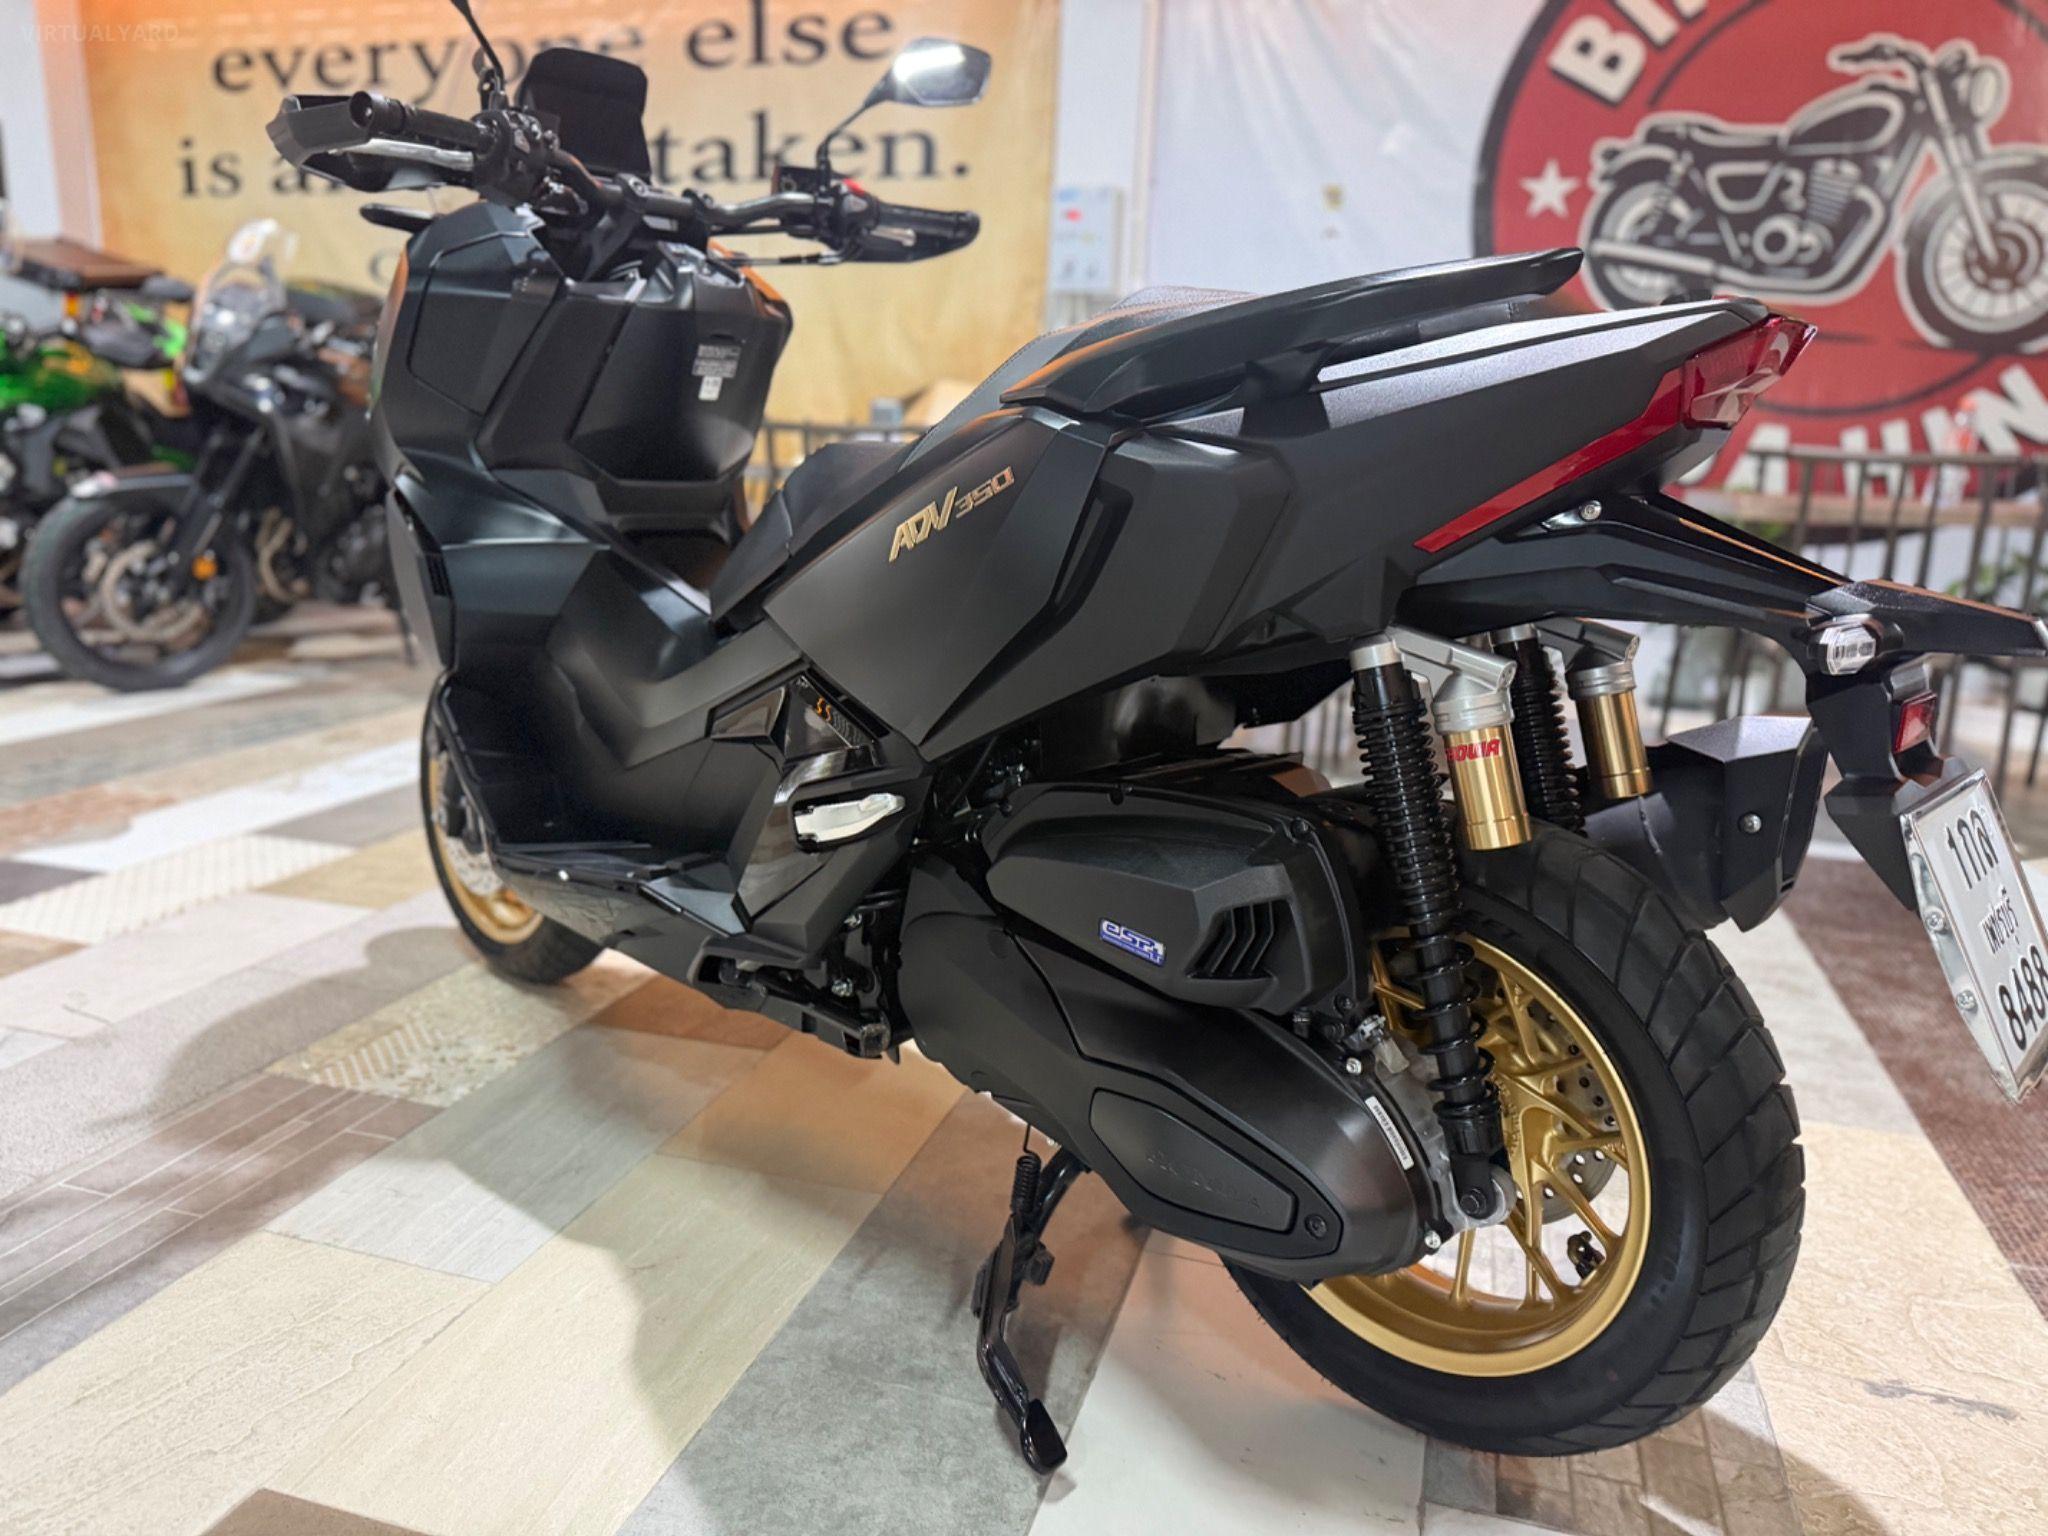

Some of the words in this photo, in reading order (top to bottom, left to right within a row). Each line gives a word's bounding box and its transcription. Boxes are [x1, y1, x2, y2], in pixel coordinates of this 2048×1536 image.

[686, 0, 894, 70] else
[1547, 0, 1708, 107] BI
[181, 135, 243, 195] is
[650, 109, 970, 185] taken.
